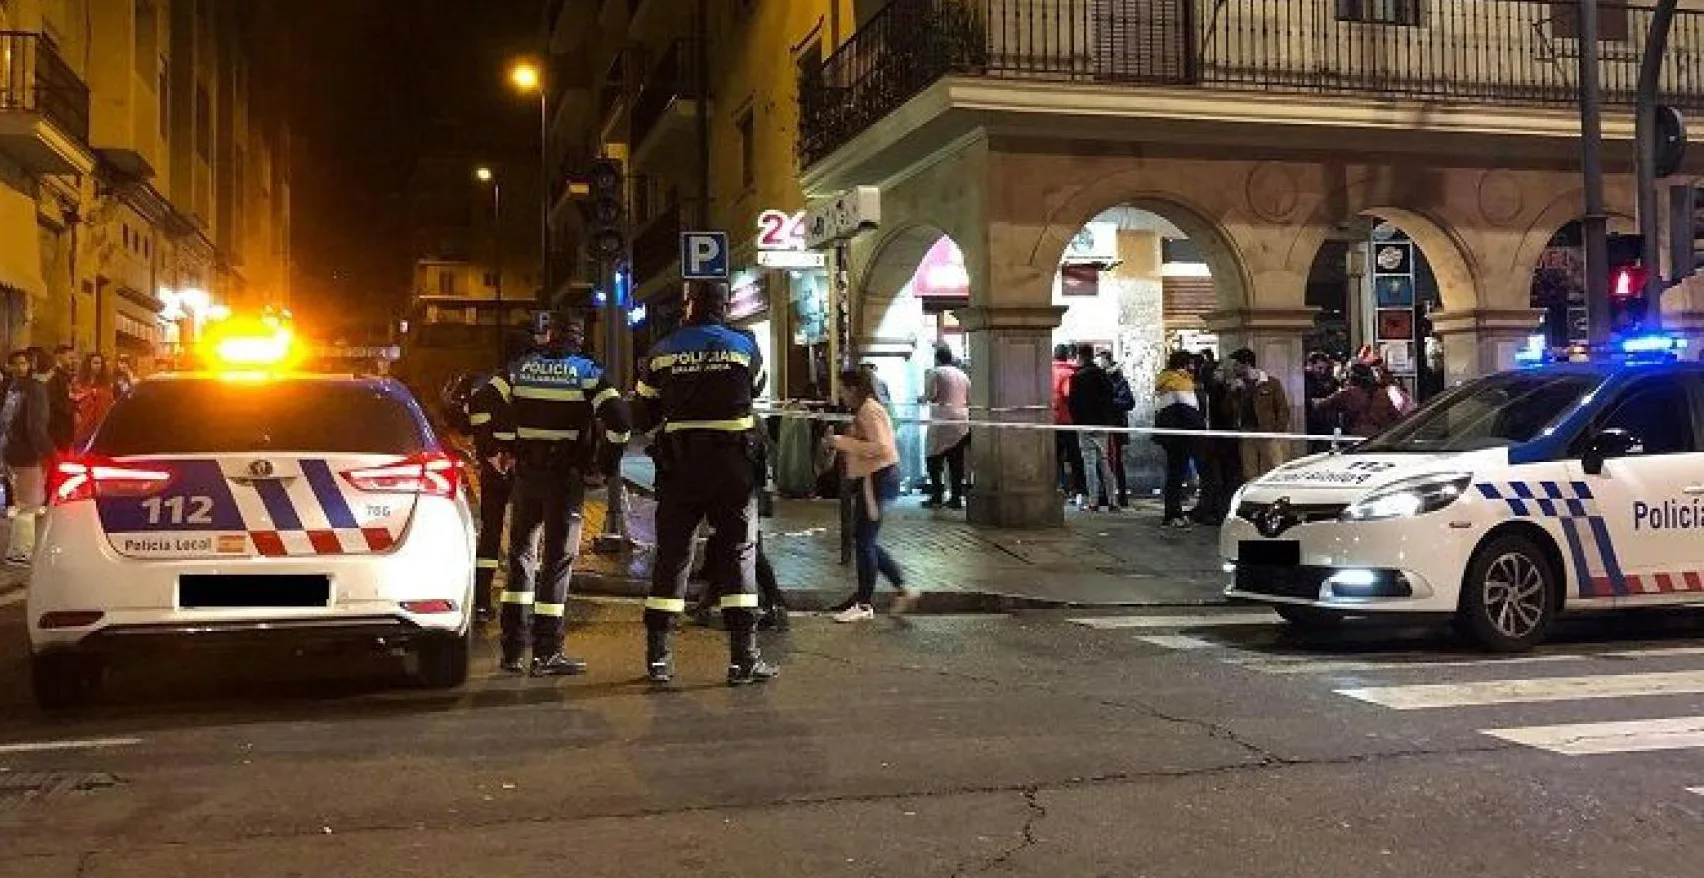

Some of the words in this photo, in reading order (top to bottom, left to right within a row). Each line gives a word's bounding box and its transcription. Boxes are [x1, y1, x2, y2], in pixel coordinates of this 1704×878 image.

[690, 236, 720, 273] P
[141, 496, 215, 525] 112
[176, 538, 212, 551] Local
